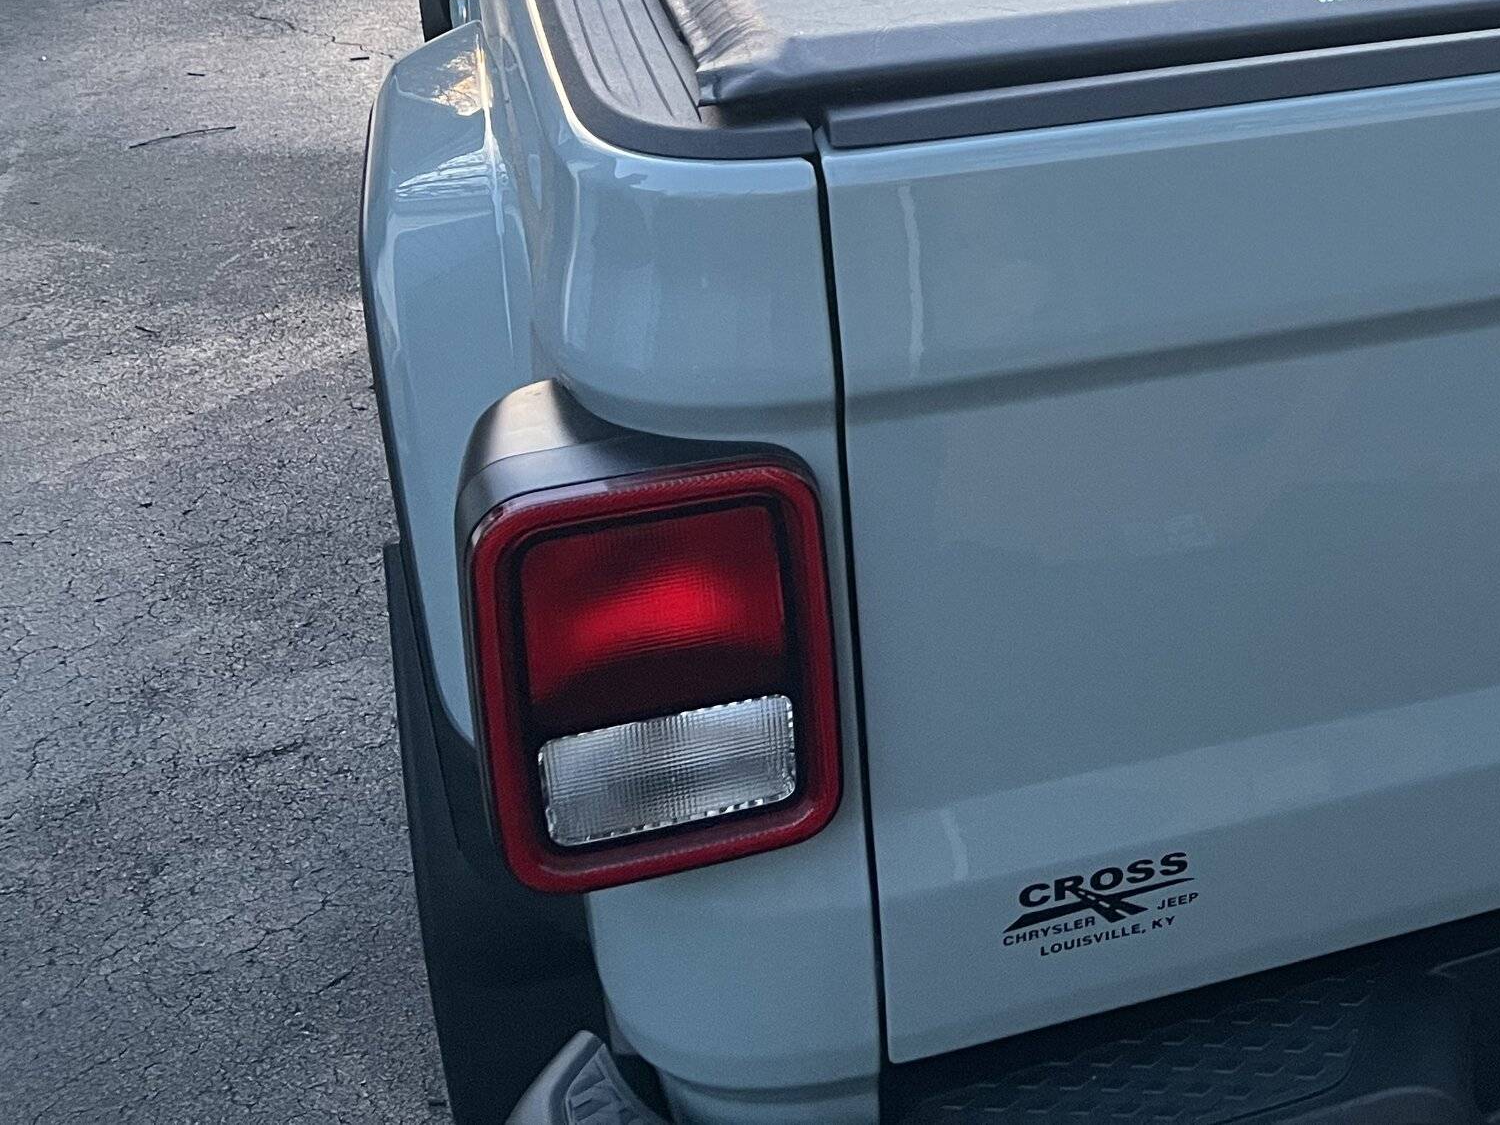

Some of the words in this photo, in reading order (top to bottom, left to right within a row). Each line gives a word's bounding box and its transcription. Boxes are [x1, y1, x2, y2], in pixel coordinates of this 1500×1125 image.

[1019, 852, 1188, 907] CROSS
[1003, 916, 1096, 946] CHRYSLER
[1157, 892, 1198, 910] JEEP
[1040, 923, 1147, 956] LOUISVILLE,
[1152, 916, 1176, 929] KY
